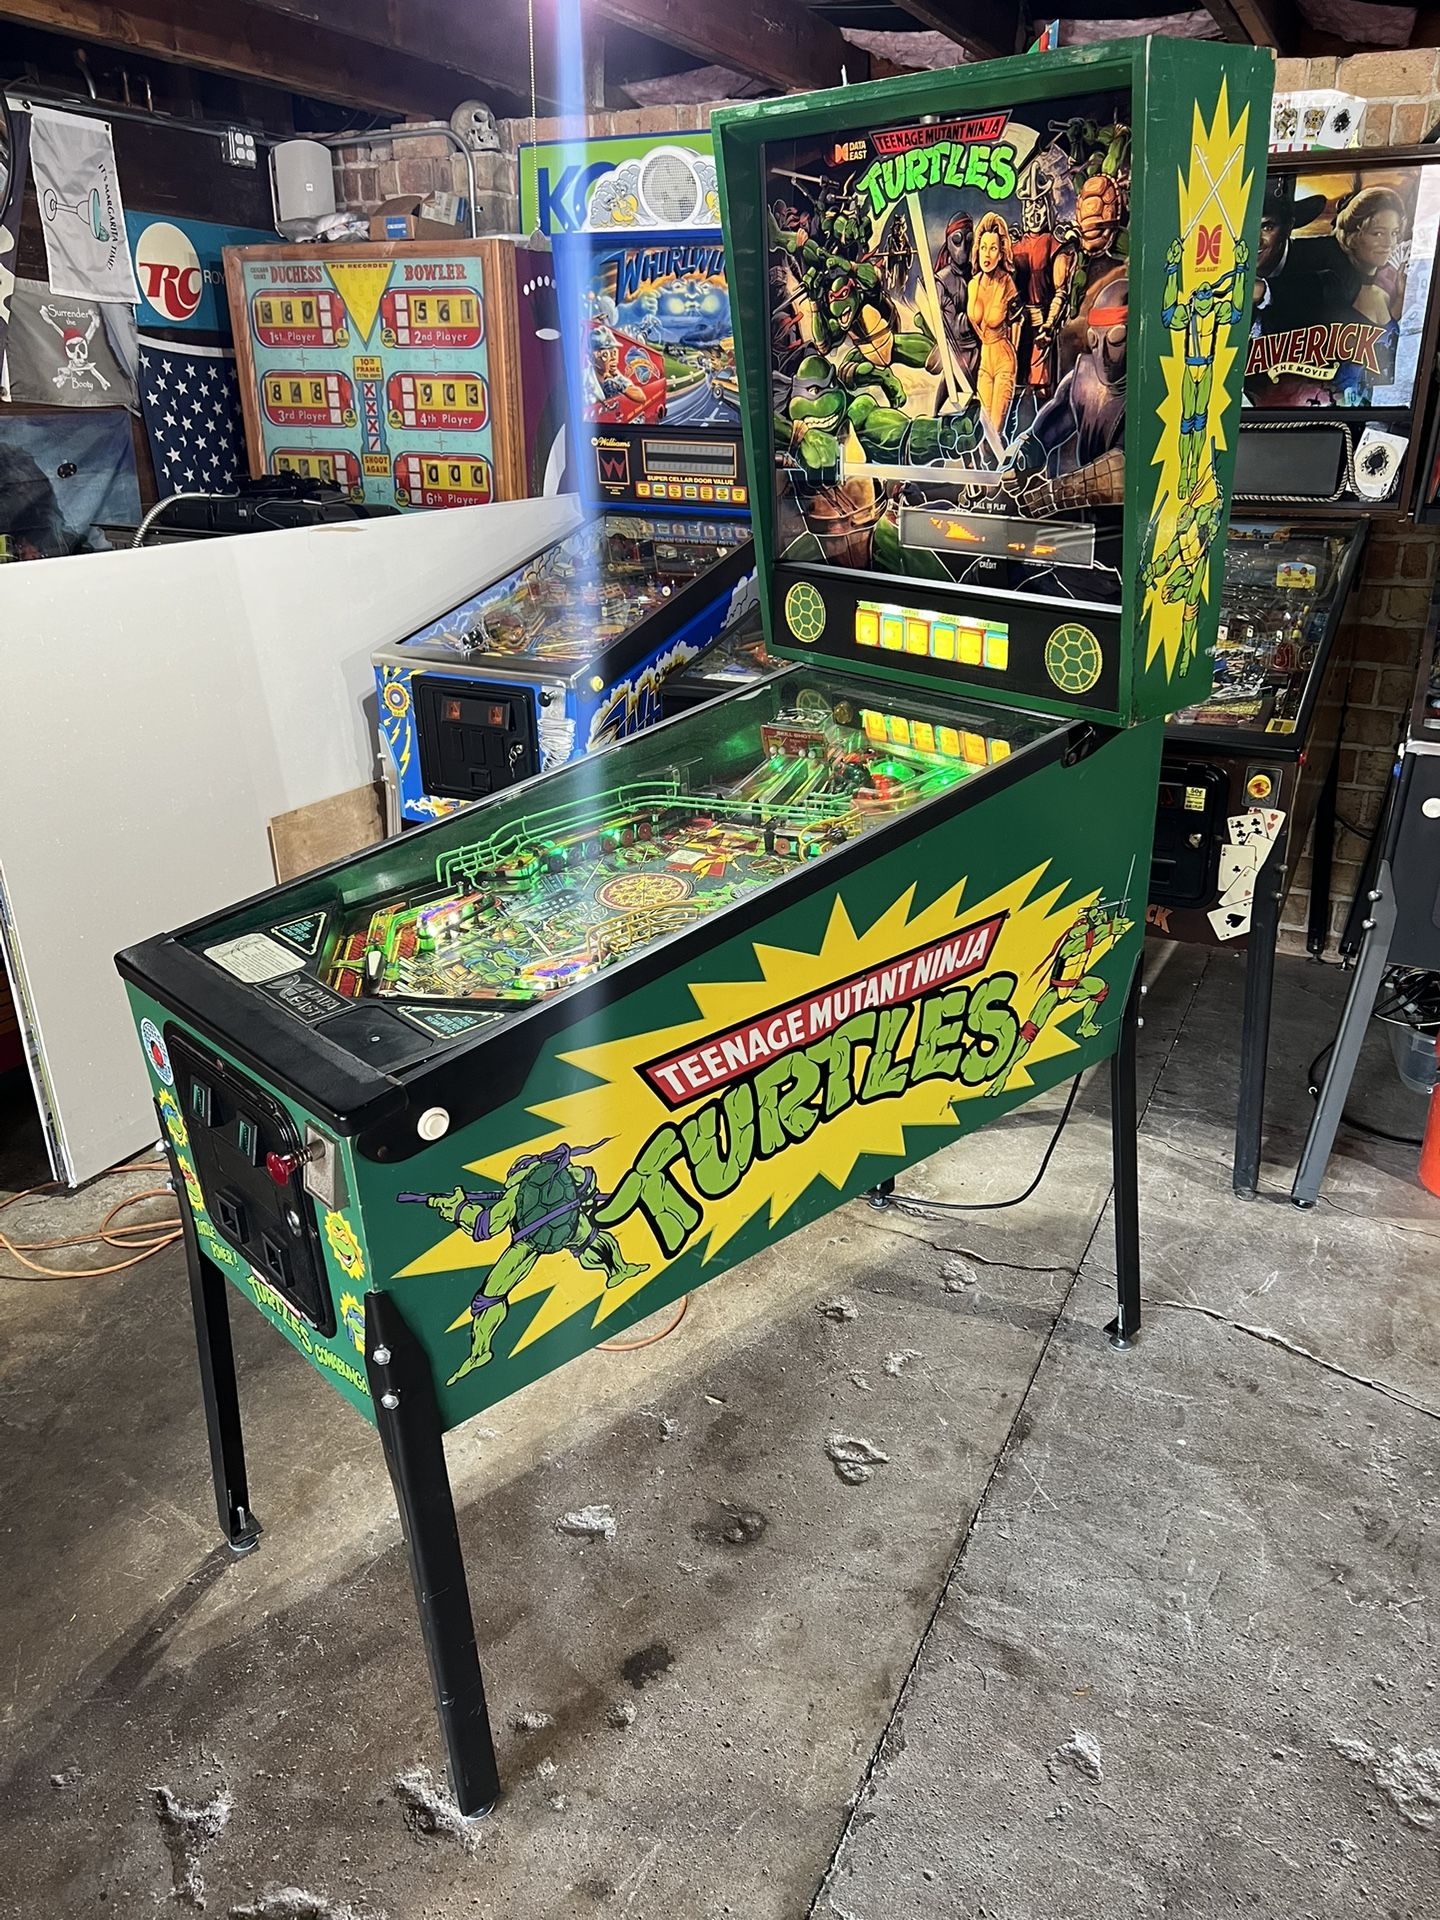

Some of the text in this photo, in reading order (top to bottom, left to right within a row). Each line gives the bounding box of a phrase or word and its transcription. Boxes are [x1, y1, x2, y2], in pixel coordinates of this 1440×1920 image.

[876, 118, 999, 150] TEENAGE MUTANT NINJA
[850, 140, 867, 150] DATA
[850, 150, 867, 161] EAST
[856, 141, 1017, 215] TURTLES
[104, 184, 119, 242] MARGARITA
[270, 265, 323, 284] DUCHESS
[404, 264, 467, 281] BOWLER
[138, 262, 201, 318] RC
[48, 304, 89, 318] Surrender
[269, 332, 316, 344] 1st Player
[414, 331, 468, 344] 2nd Player
[1245, 323, 1387, 376] AVERICK
[1274, 364, 1328, 377] THE MOVIE
[71, 377, 94, 392] Booty
[278, 410, 327, 423] 3rd Player
[420, 413, 473, 427] 4th Player
[599, 436, 631, 449] Williams
[364, 456, 388, 464] SHOOT
[366, 465, 389, 473] AGAIN
[426, 493, 478, 507] 6th Player
[994, 503, 1007, 511] PLAY
[979, 562, 997, 570] CREDIT
[289, 995, 326, 1018] EAST
[304, 988, 341, 1011] DATA
[655, 928, 990, 1096] TEENAGE MUTANT NINJA
[593, 973, 1017, 1257] TURTLES
[246, 1275, 314, 1354] TURTLES
